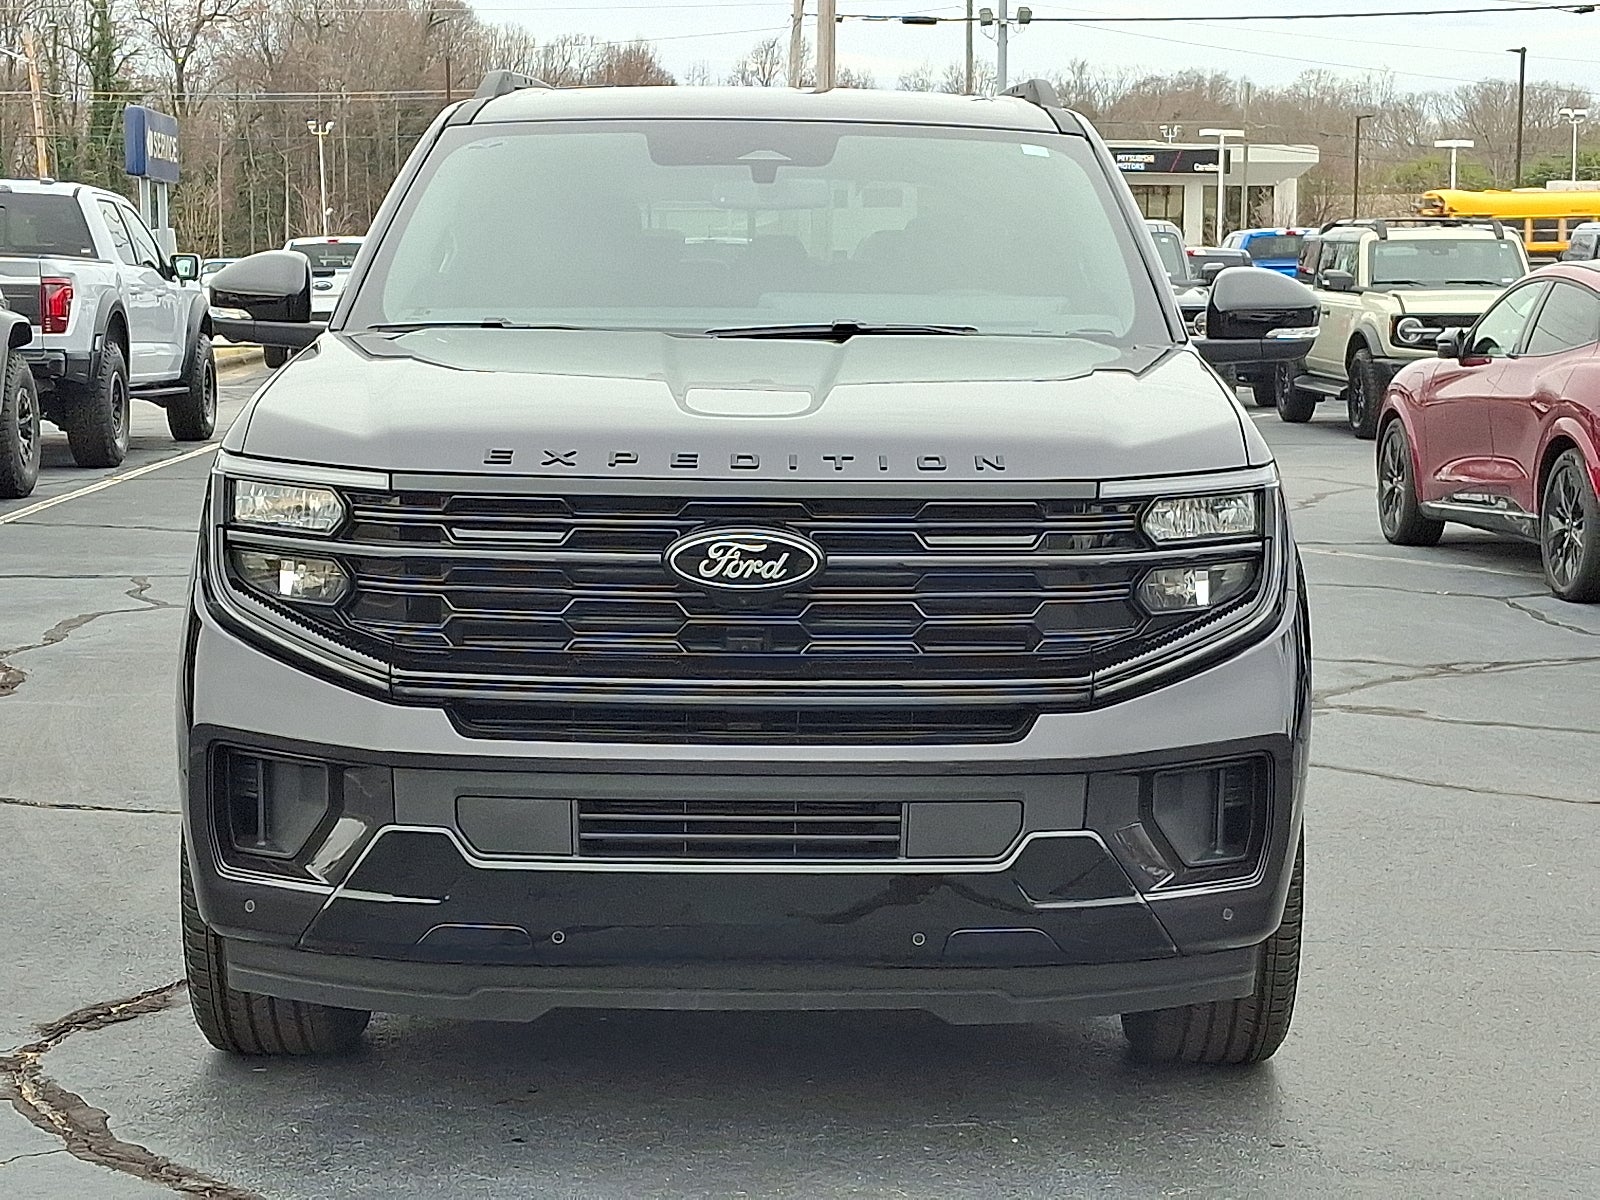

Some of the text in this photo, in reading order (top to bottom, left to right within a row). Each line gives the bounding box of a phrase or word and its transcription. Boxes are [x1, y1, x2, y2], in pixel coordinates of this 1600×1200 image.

[153, 131, 178, 163] SERVICE
[483, 449, 1006, 471] EXPEDITION
[698, 541, 790, 579] Ford
